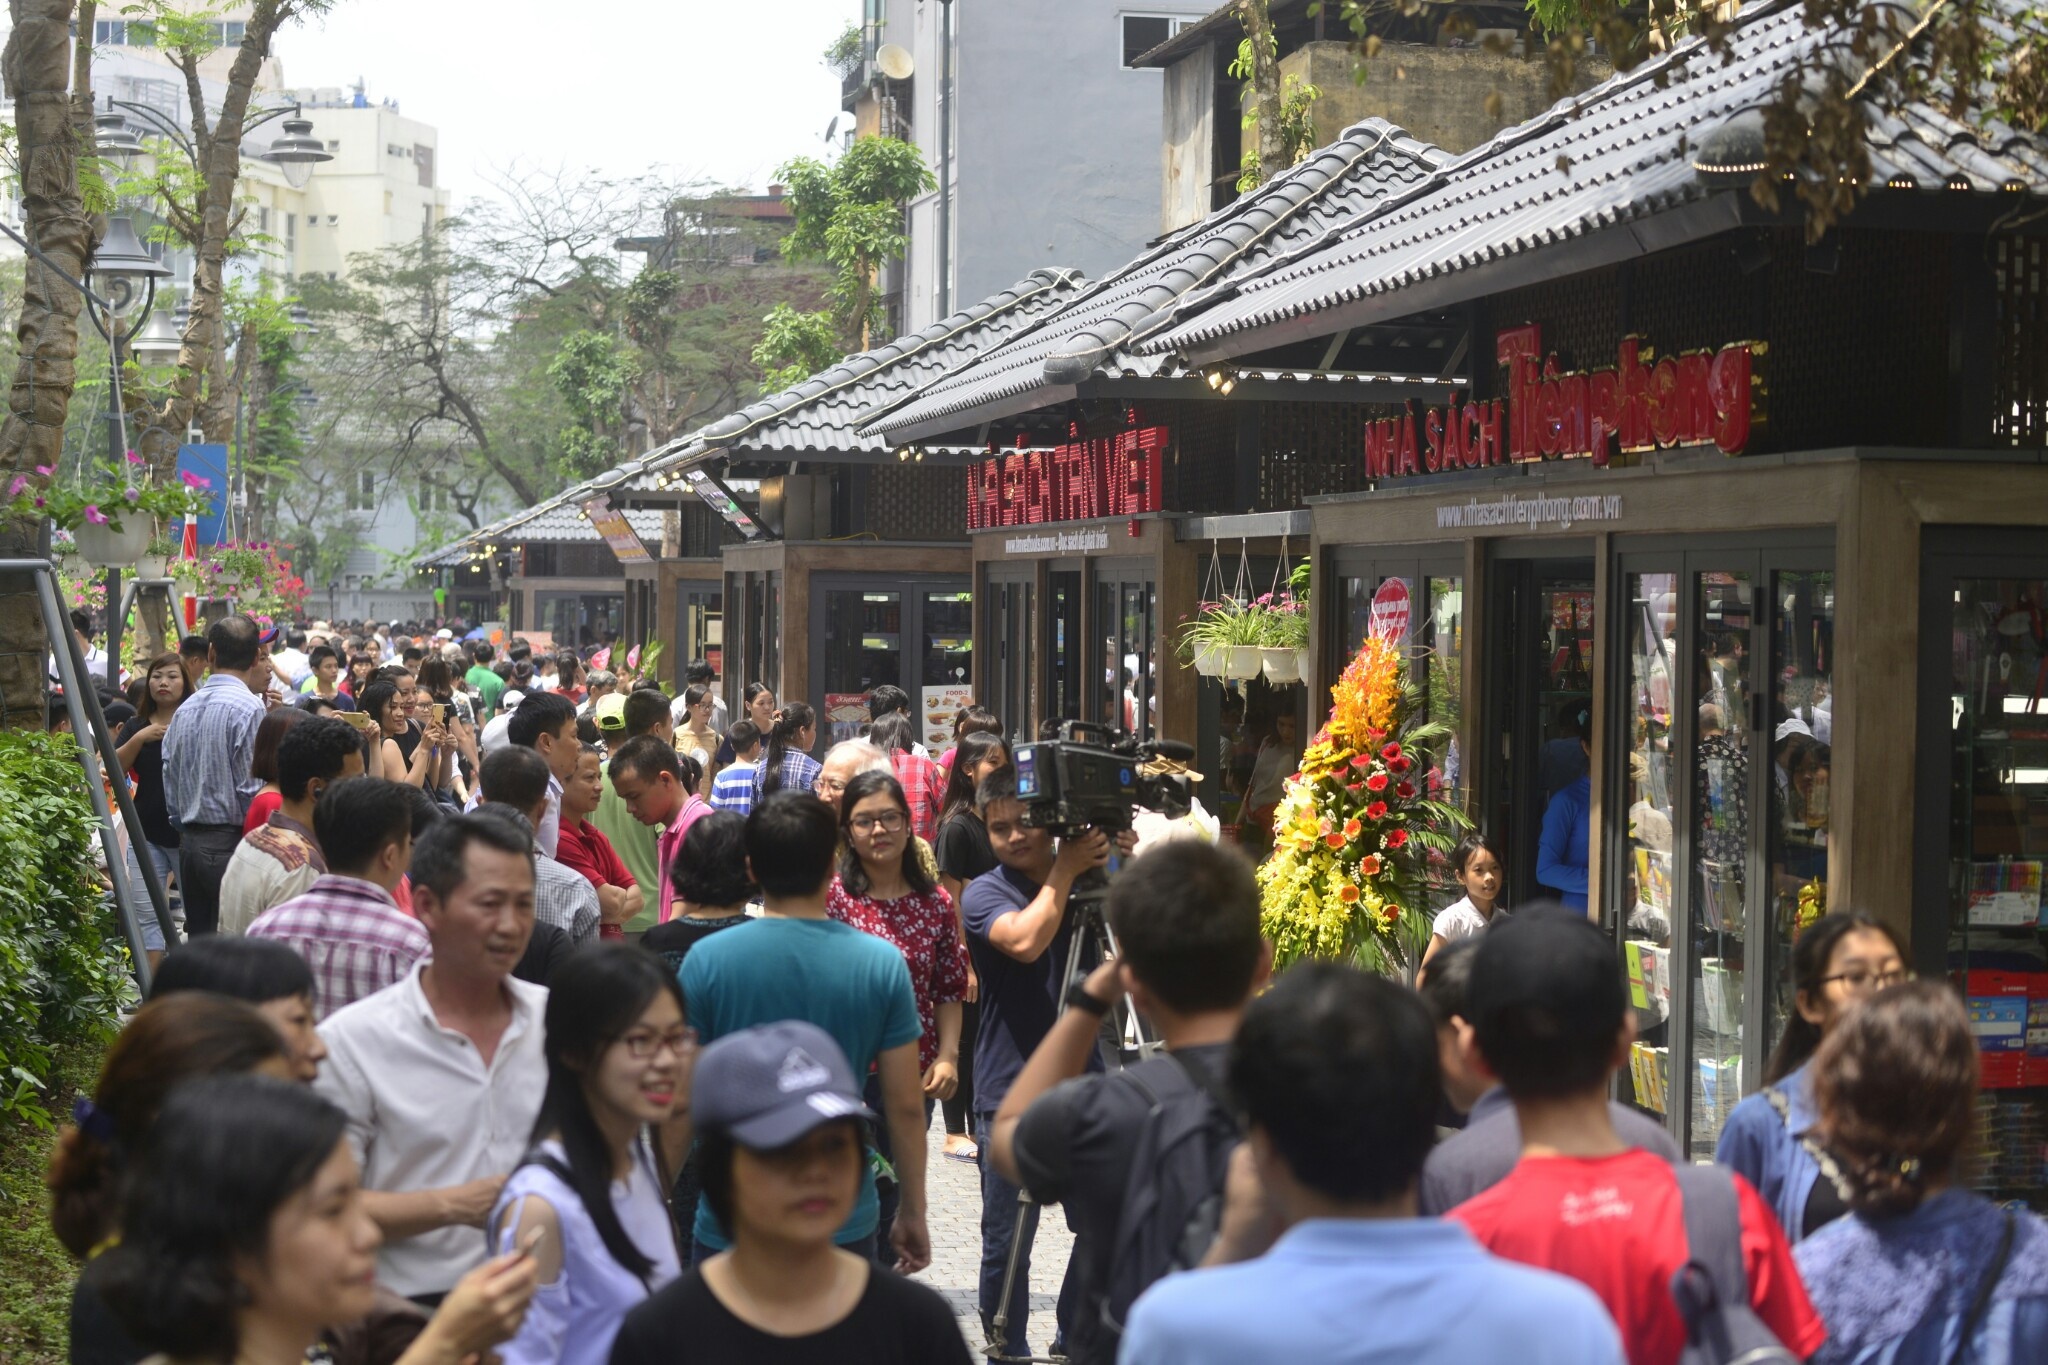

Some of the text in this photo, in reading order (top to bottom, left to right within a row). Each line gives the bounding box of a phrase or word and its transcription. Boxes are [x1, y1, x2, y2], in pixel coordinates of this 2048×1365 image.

[966, 407, 1169, 538] NHÀ SÁCH TÂN VIỆT
[1364, 398, 1421, 479] NHÀ
[1424, 392, 1504, 474] SÁCH
[1436, 491, 1623, 530] www.nhasachtienphong.com.vn
